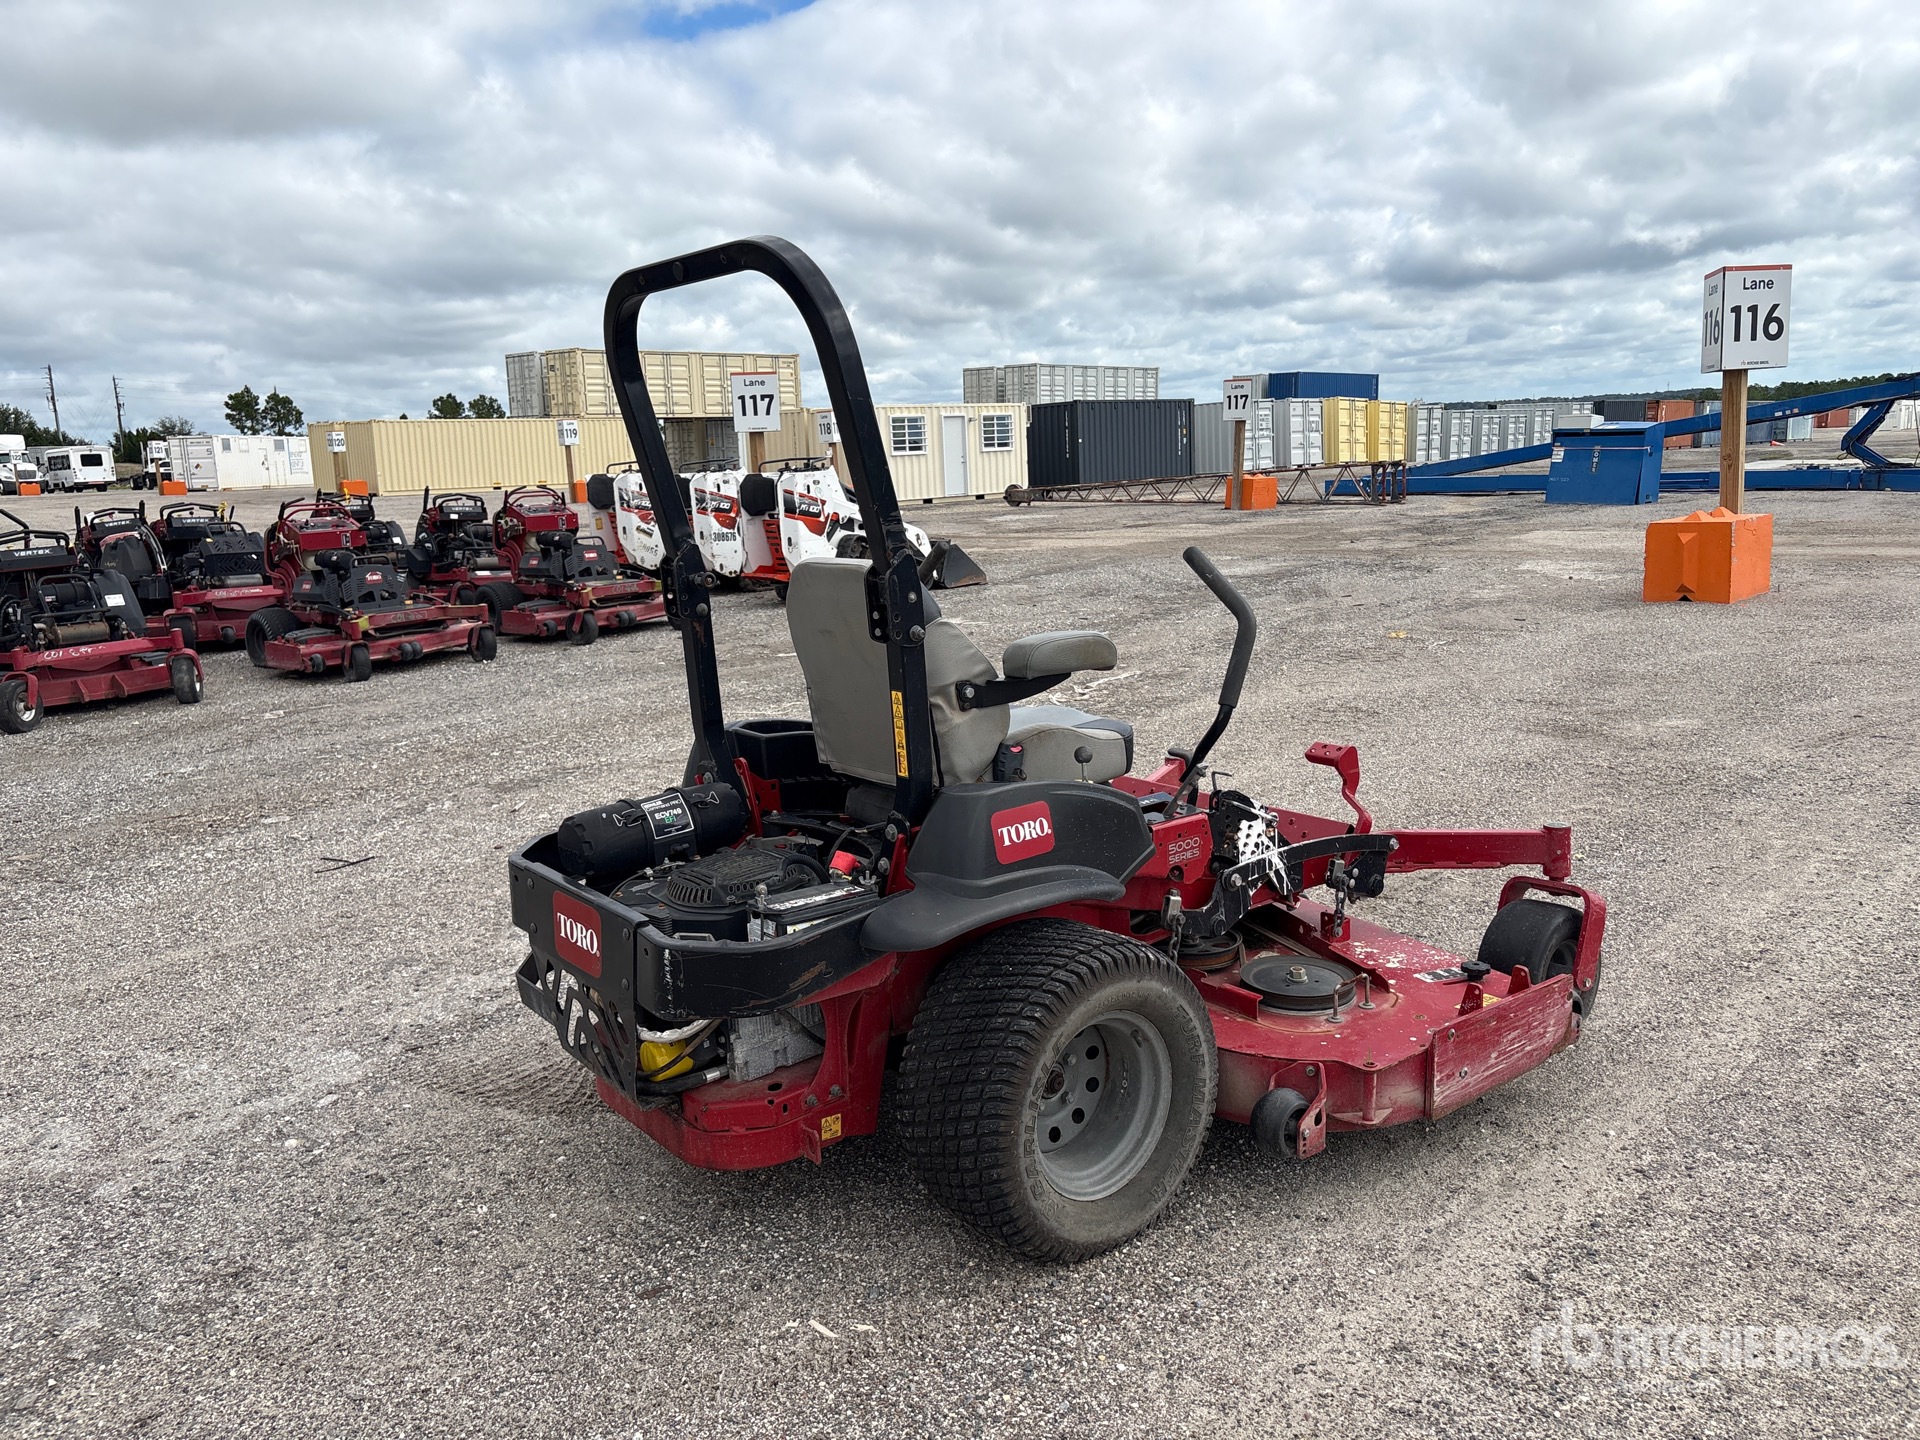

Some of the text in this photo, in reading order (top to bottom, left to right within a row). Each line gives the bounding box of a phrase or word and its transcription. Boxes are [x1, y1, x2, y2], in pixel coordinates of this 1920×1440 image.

[1708, 284, 1718, 296] Lane
[1742, 277, 1774, 290] Lane
[1704, 307, 1720, 347] 116
[1730, 303, 1785, 342] 116
[743, 379, 766, 387] Lane
[737, 393, 775, 417] 117
[1226, 394, 1249, 410] 117
[565, 428, 578, 439] 119
[819, 423, 832, 435] 118
[333, 438, 345, 447] 120
[154, 446, 163, 454] 121
[13, 549, 51, 557] VERTEX
[654, 807, 682, 820] ECV749
[664, 815, 677, 824] EFI
[997, 817, 1049, 847] TORO
[1168, 837, 1200, 854] 5000
[1168, 848, 1200, 864] SERIES
[557, 912, 598, 955] TORO
